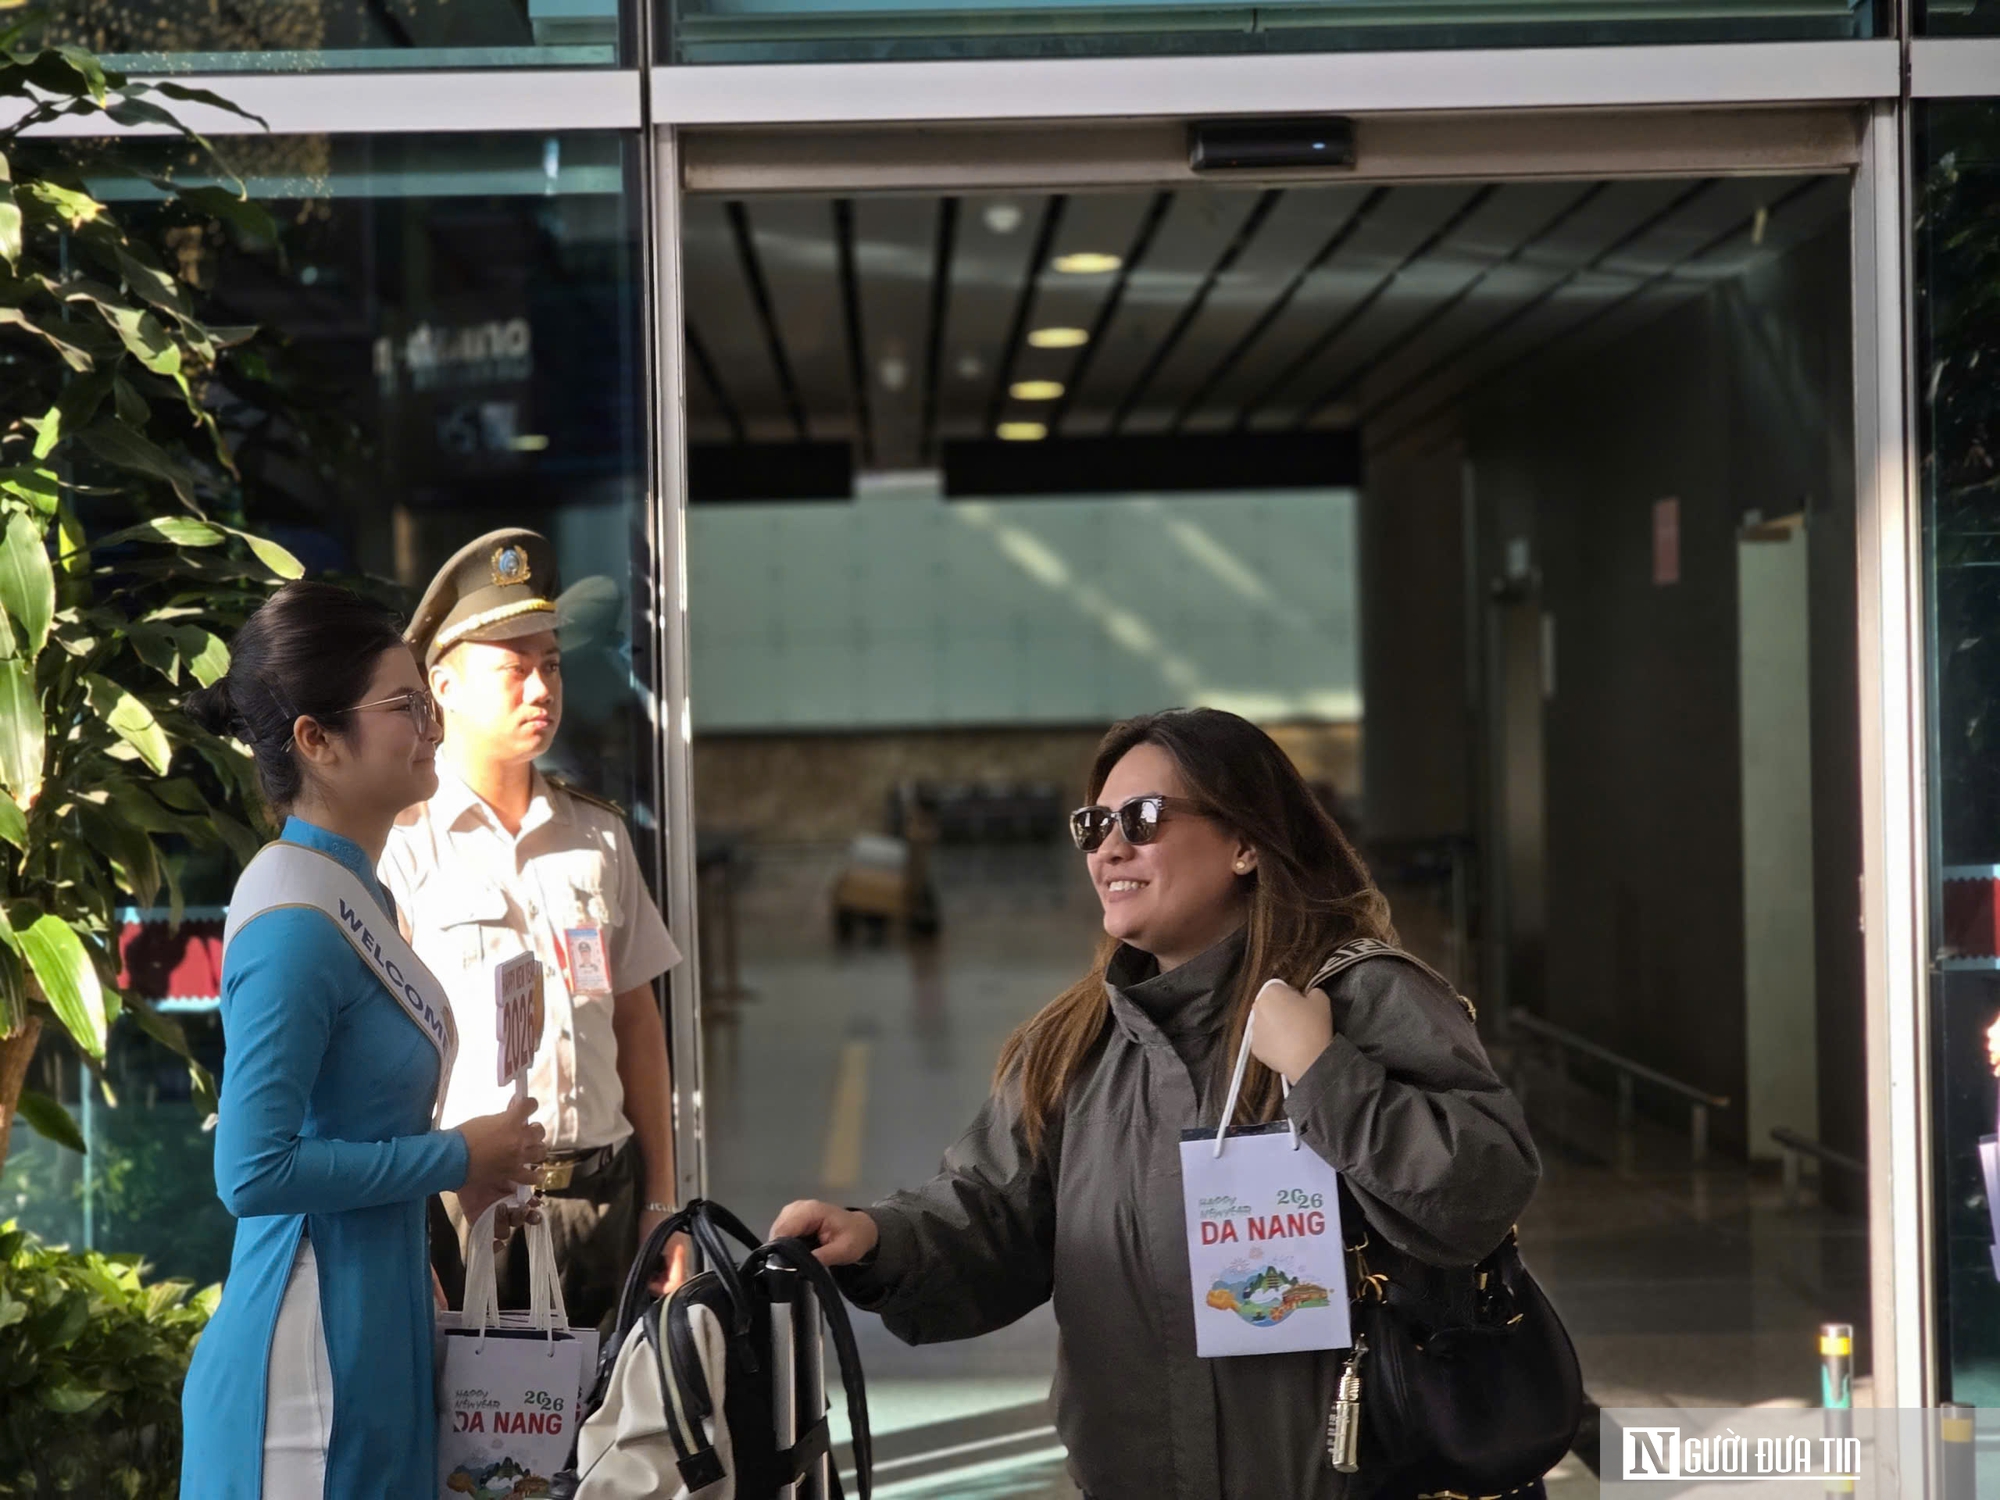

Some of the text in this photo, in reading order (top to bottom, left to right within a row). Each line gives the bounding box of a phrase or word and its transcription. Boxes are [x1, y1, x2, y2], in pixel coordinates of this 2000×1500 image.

[503, 987, 535, 1078] 2026
[1277, 1188, 1324, 1209] 2026
[1201, 1211, 1325, 1246] DA NANG
[524, 1390, 564, 1412] 2026
[453, 1410, 563, 1436] DA NANG
